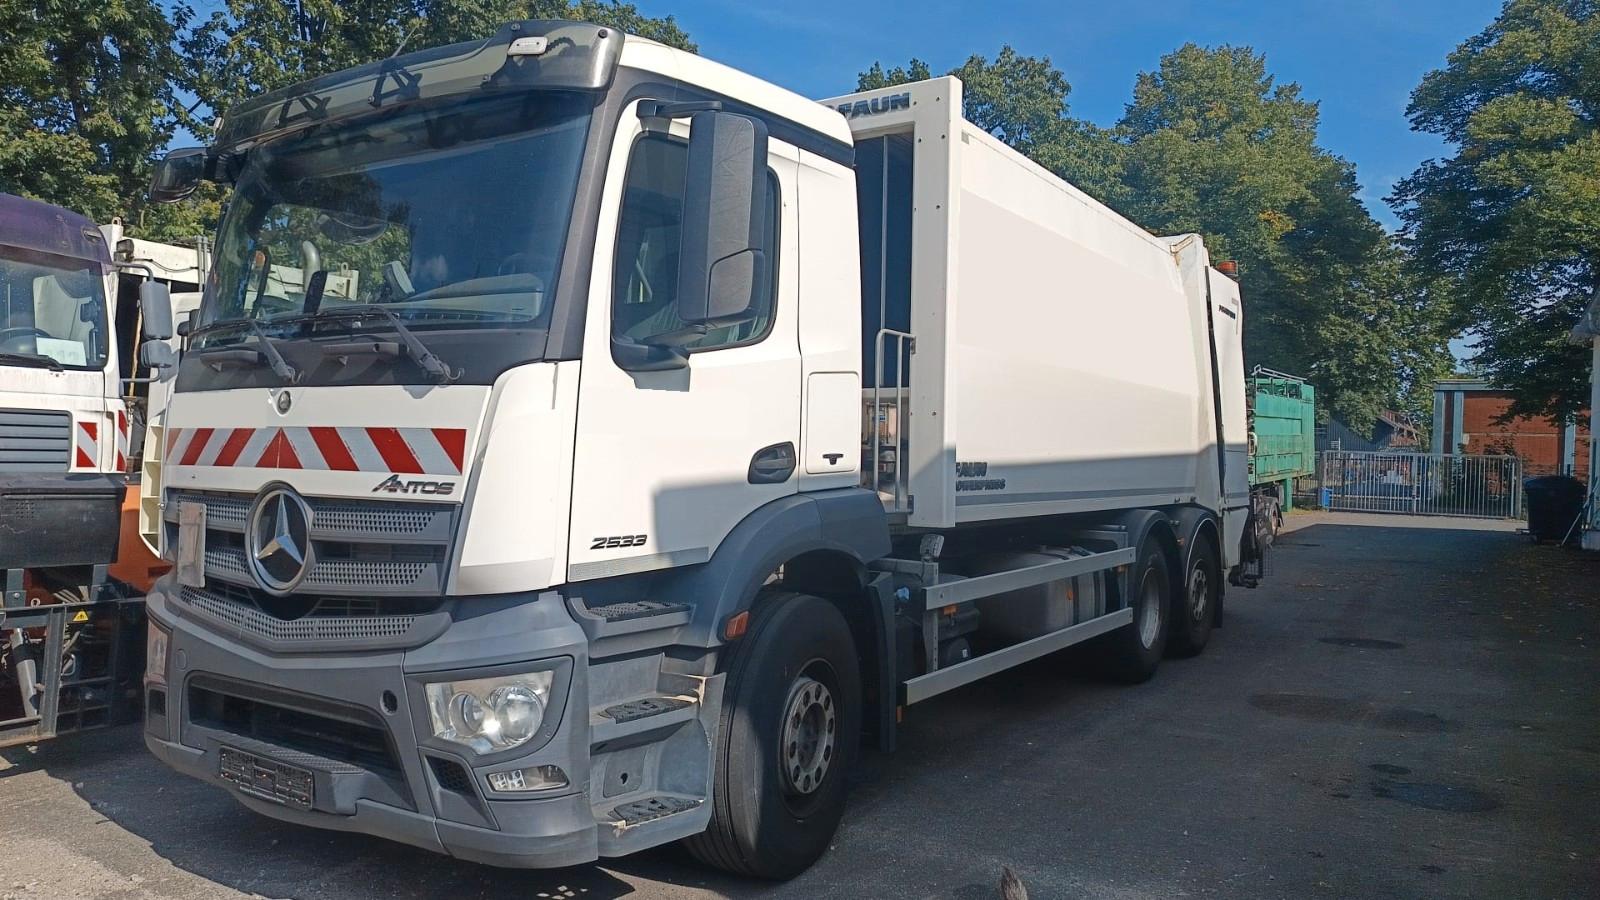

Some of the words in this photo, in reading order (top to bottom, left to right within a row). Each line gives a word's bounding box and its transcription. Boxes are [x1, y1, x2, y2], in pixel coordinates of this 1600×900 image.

[837, 92, 910, 119] FAUN
[371, 474, 456, 495] ANTOS
[590, 534, 648, 550] 2533
